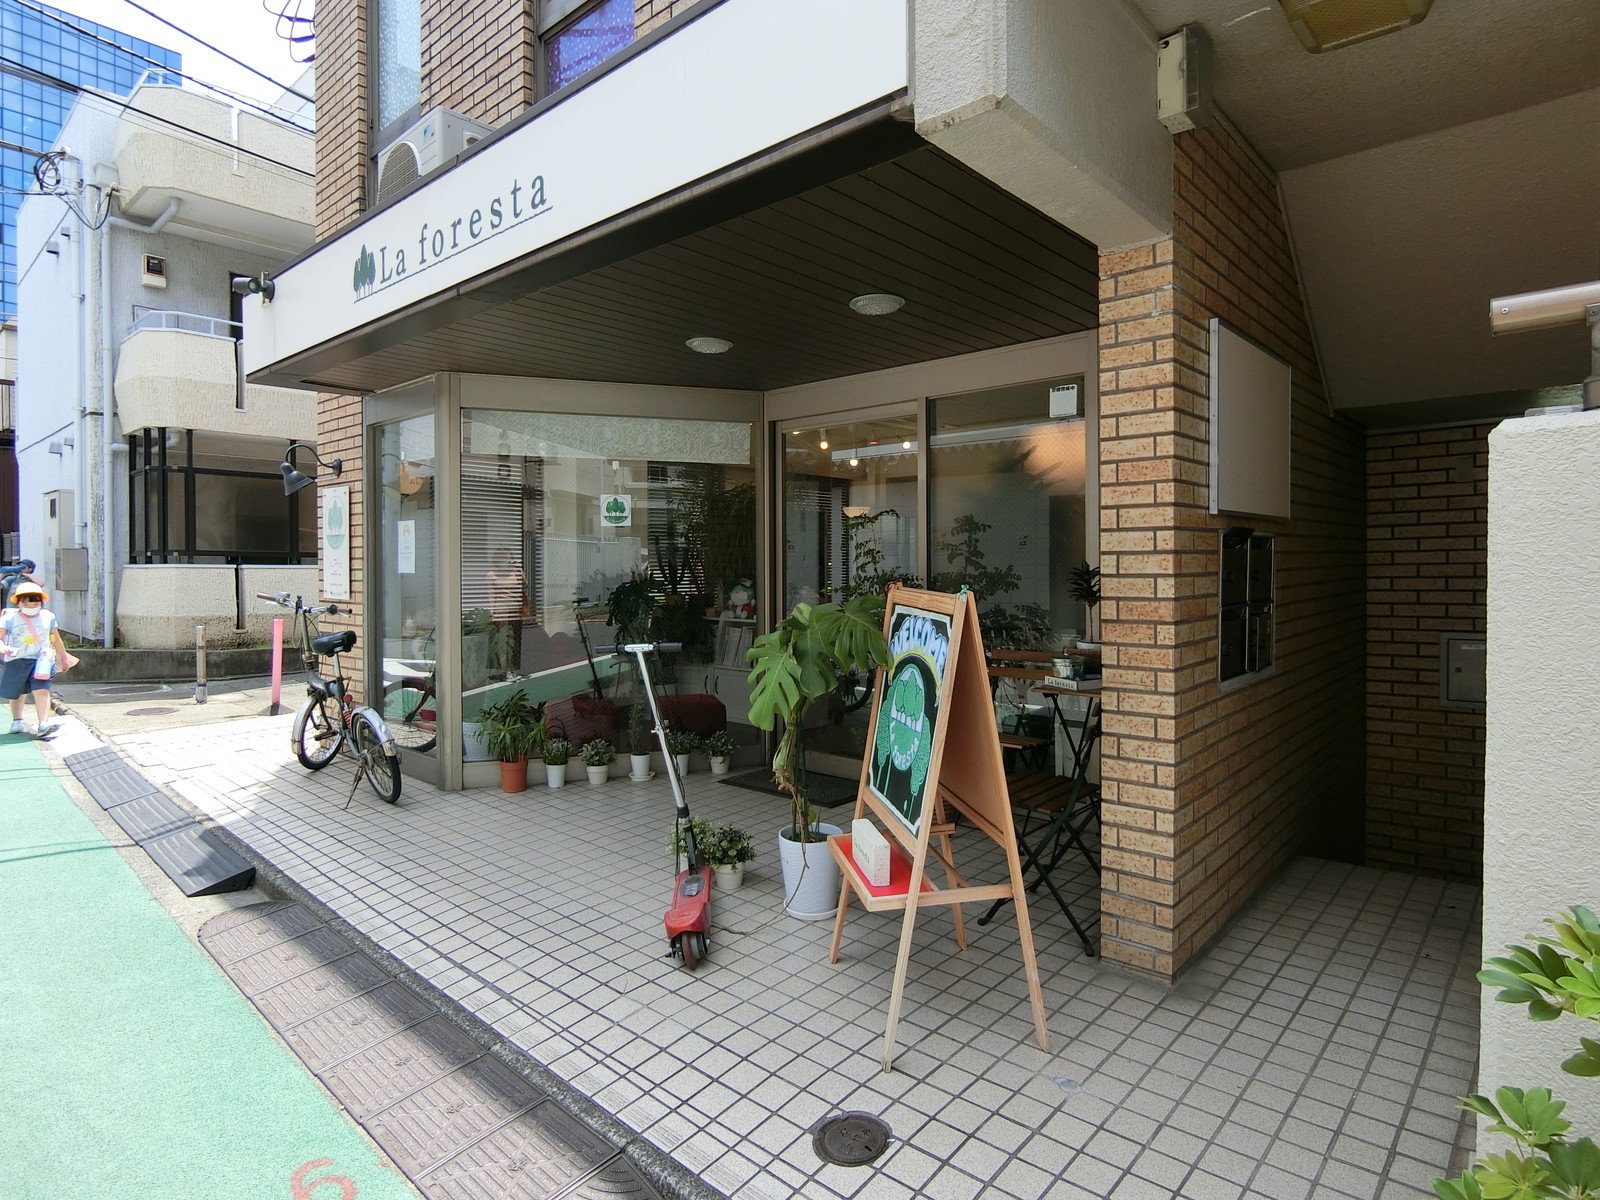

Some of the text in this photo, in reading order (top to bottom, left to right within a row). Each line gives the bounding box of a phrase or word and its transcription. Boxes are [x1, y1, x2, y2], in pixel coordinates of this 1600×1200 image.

[379, 174, 547, 284] La foresta
[889, 615, 948, 680] WELCOME
[891, 736, 919, 768] foresta
